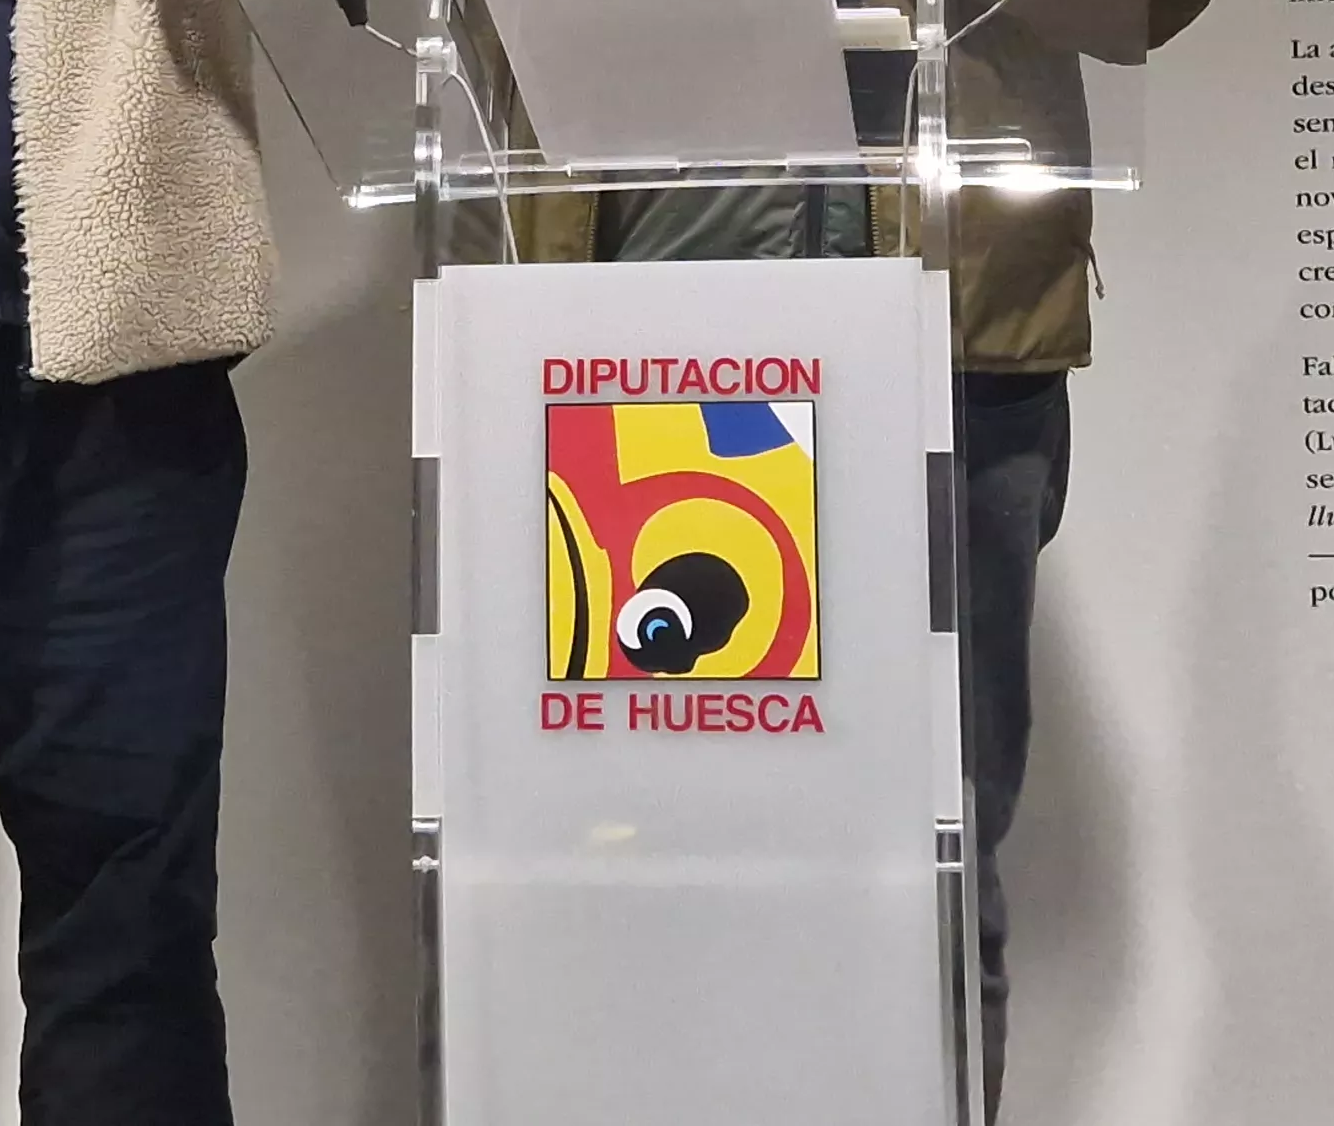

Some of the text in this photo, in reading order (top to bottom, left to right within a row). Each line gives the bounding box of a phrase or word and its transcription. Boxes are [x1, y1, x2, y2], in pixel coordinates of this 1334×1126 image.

[1292, 40, 1319, 58] La
[1295, 149, 1317, 170] el
[542, 358, 821, 395] DIPUTACION
[540, 692, 825, 734] DE HUESCA
